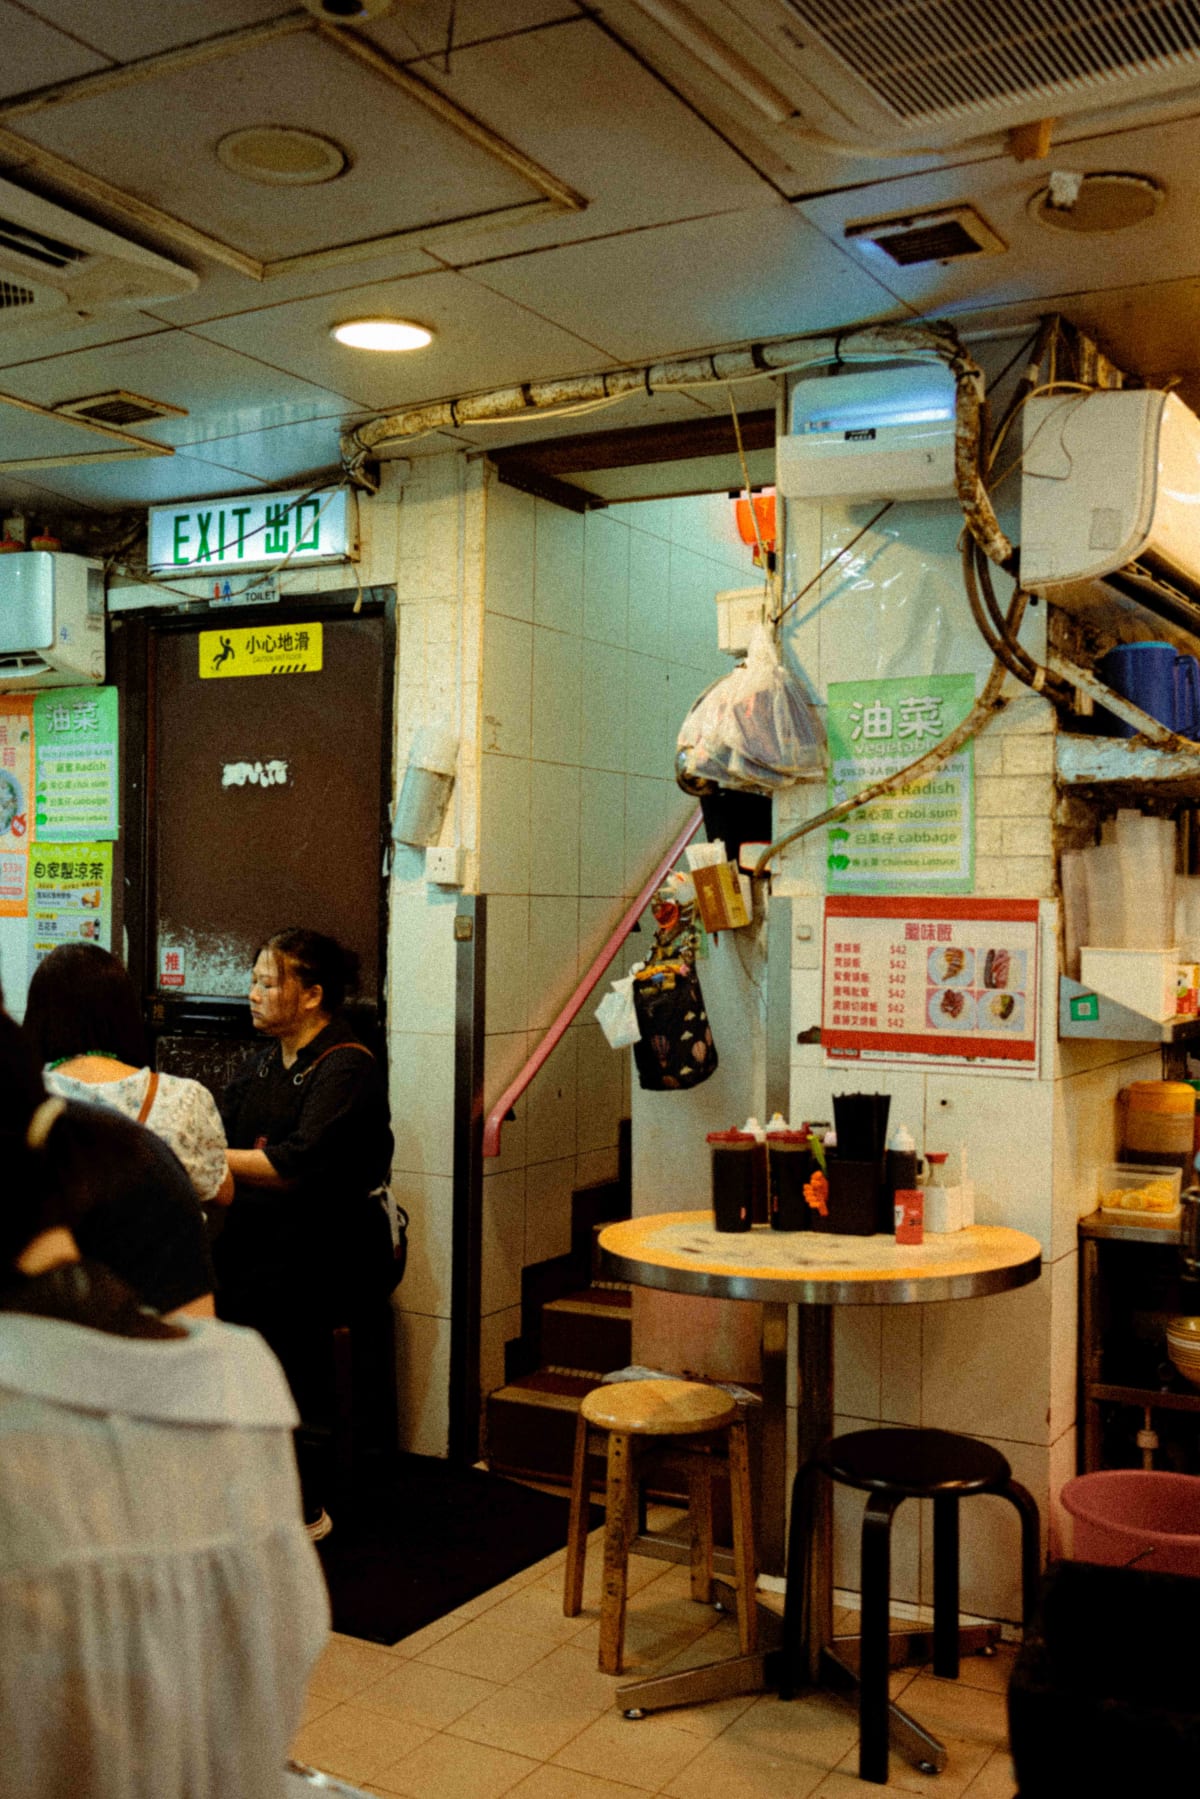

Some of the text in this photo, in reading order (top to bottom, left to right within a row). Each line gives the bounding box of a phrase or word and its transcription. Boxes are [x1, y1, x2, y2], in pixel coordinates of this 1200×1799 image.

[173, 499, 320, 564] EXIT 出口
[245, 590, 276, 602] TOILET
[246, 632, 310, 654] 小心地滑
[46, 701, 99, 733] 油菜
[849, 696, 943, 740] 油菜
[902, 782, 955, 796] Radish
[898, 807, 926, 819] choi
[929, 808, 957, 818] sum
[898, 831, 957, 844] cabbage
[34, 862, 104, 880] 自家製涼茶
[889, 944, 907, 955] $42
[165, 952, 180, 971] 推
[889, 959, 907, 969] $42
[888, 974, 906, 984] $42
[888, 988, 906, 999] $42
[887, 1003, 905, 1014] $42
[887, 1017, 905, 1028] $42
